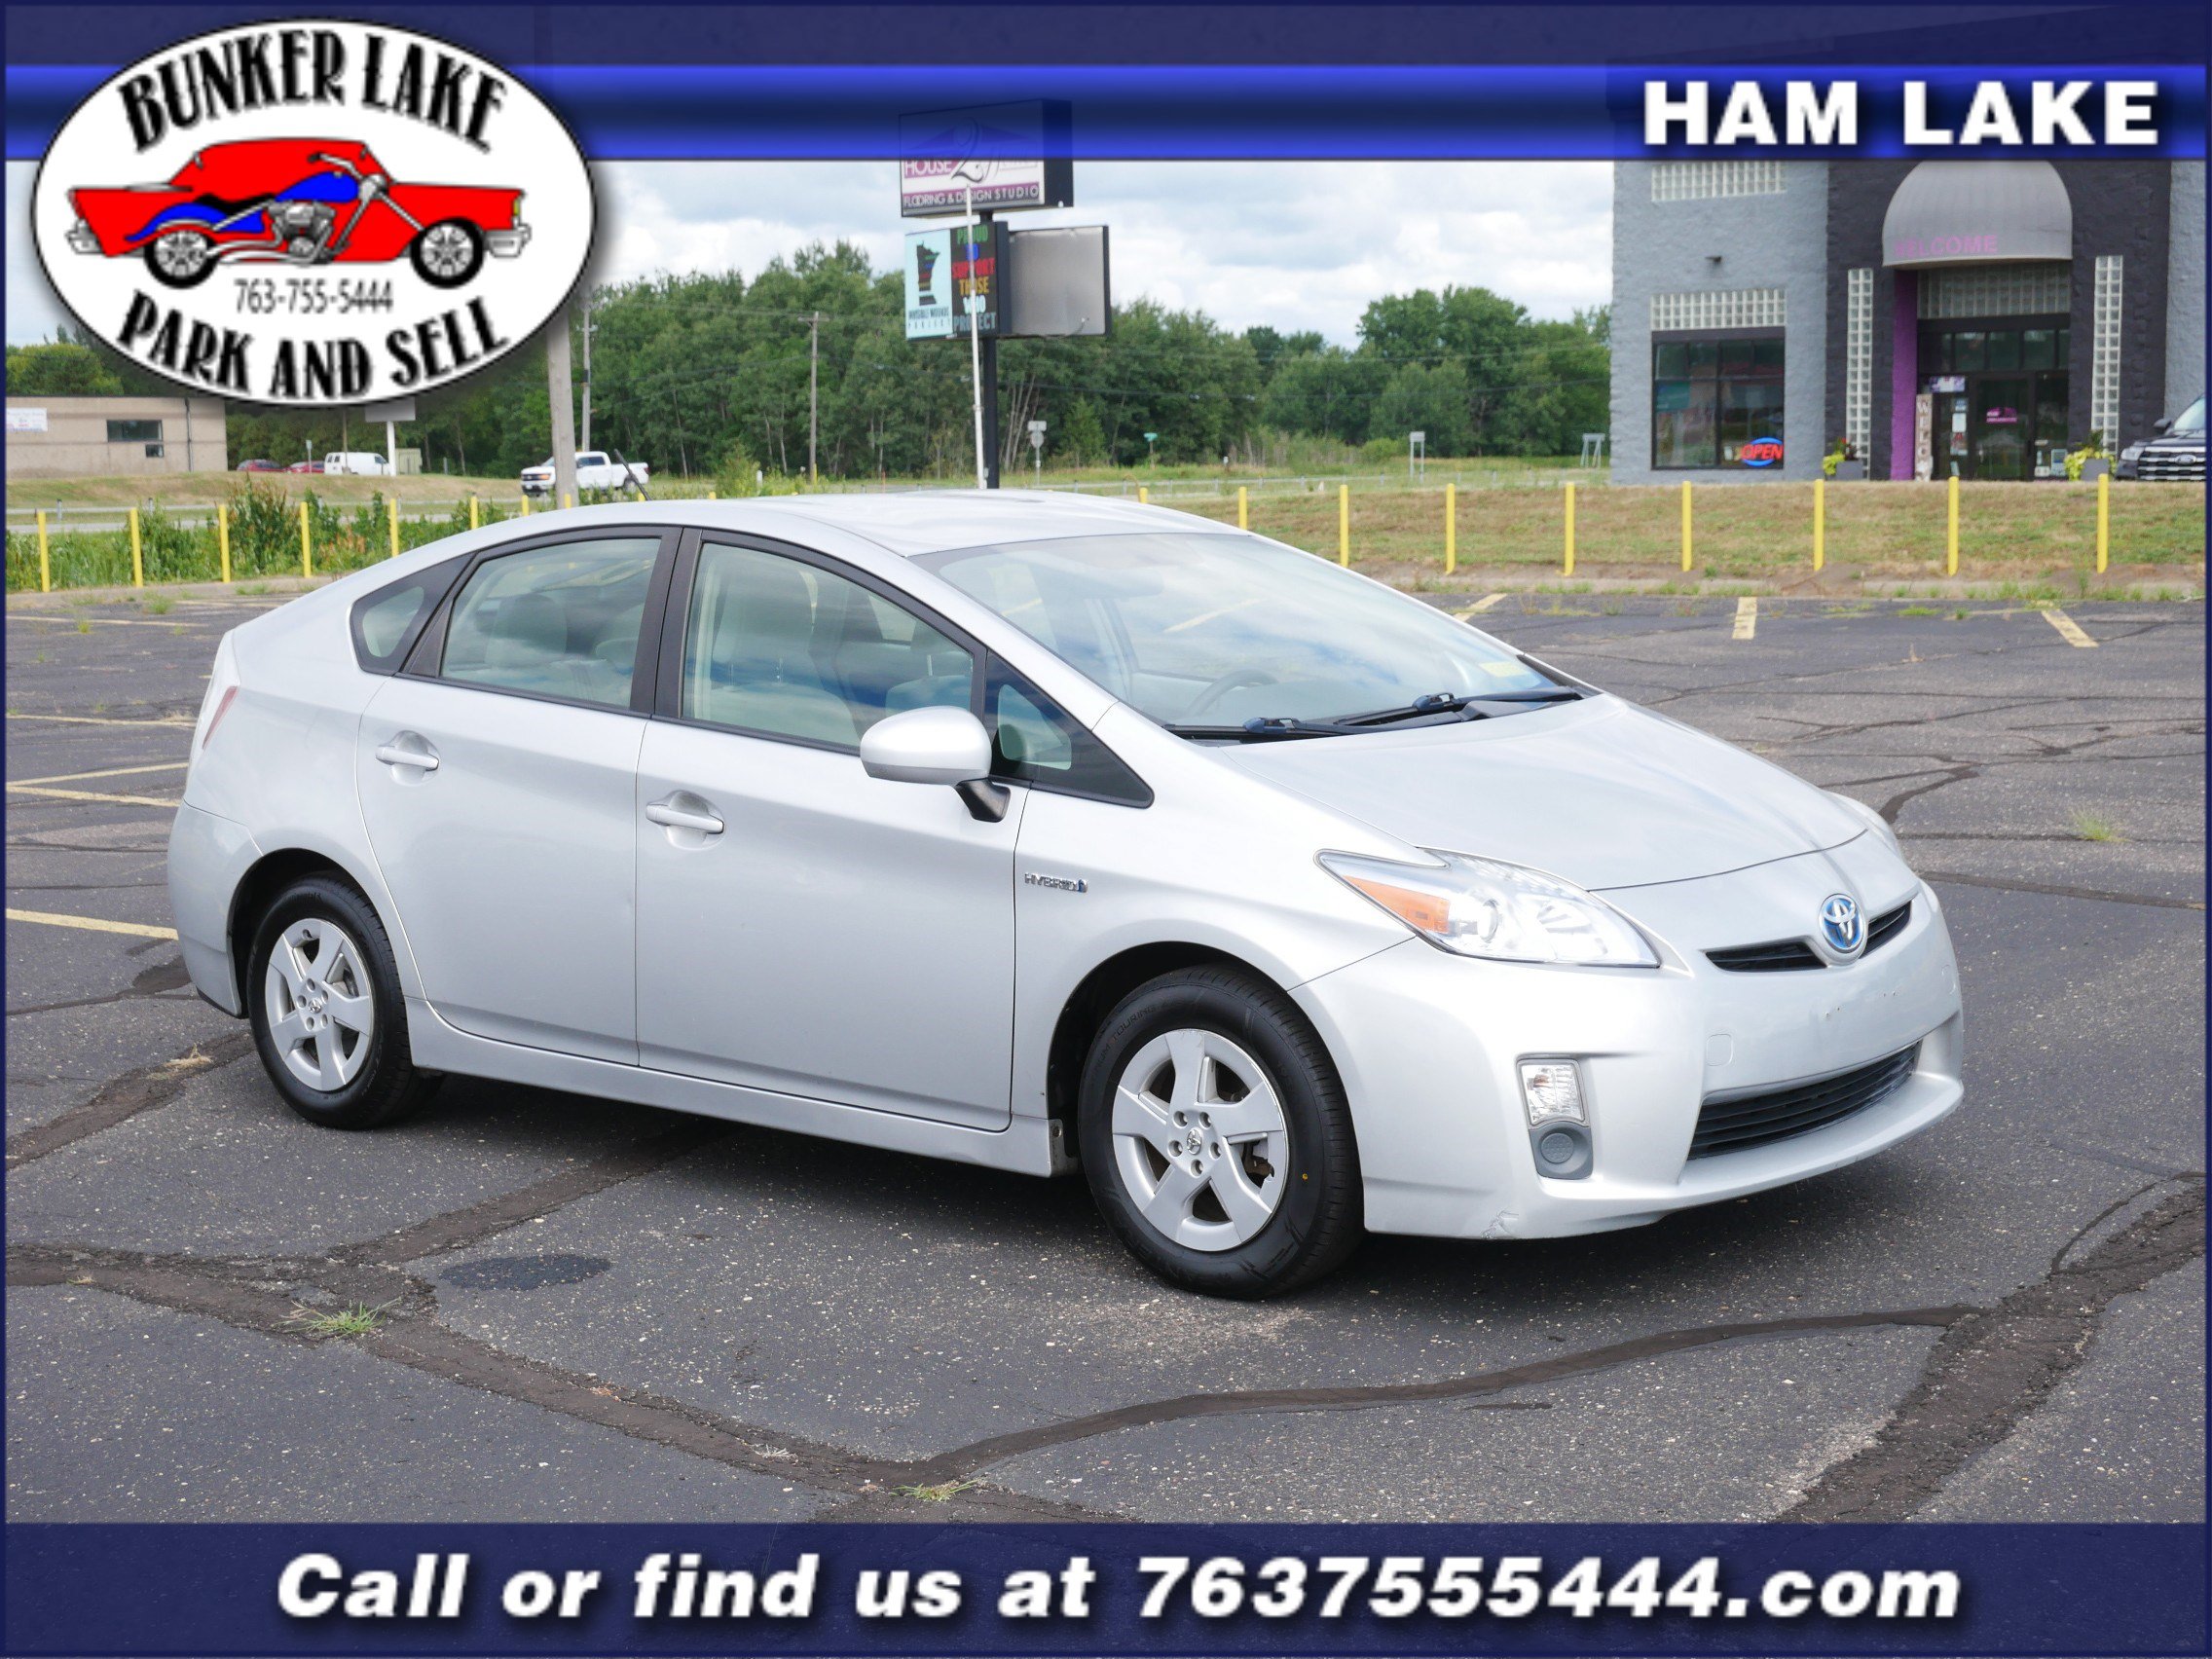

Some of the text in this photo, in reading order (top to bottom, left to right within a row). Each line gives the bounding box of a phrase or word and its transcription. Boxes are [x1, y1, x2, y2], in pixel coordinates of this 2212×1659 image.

[903, 192, 946, 207] FLOORING
[947, 193, 955, 204] &
[994, 184, 1040, 200] STUDIO
[951, 258, 995, 279] SUPORT
[953, 313, 997, 332] PROECT
[1741, 443, 1783, 460] OPEN
[1024, 872, 1077, 892] HYBRID
